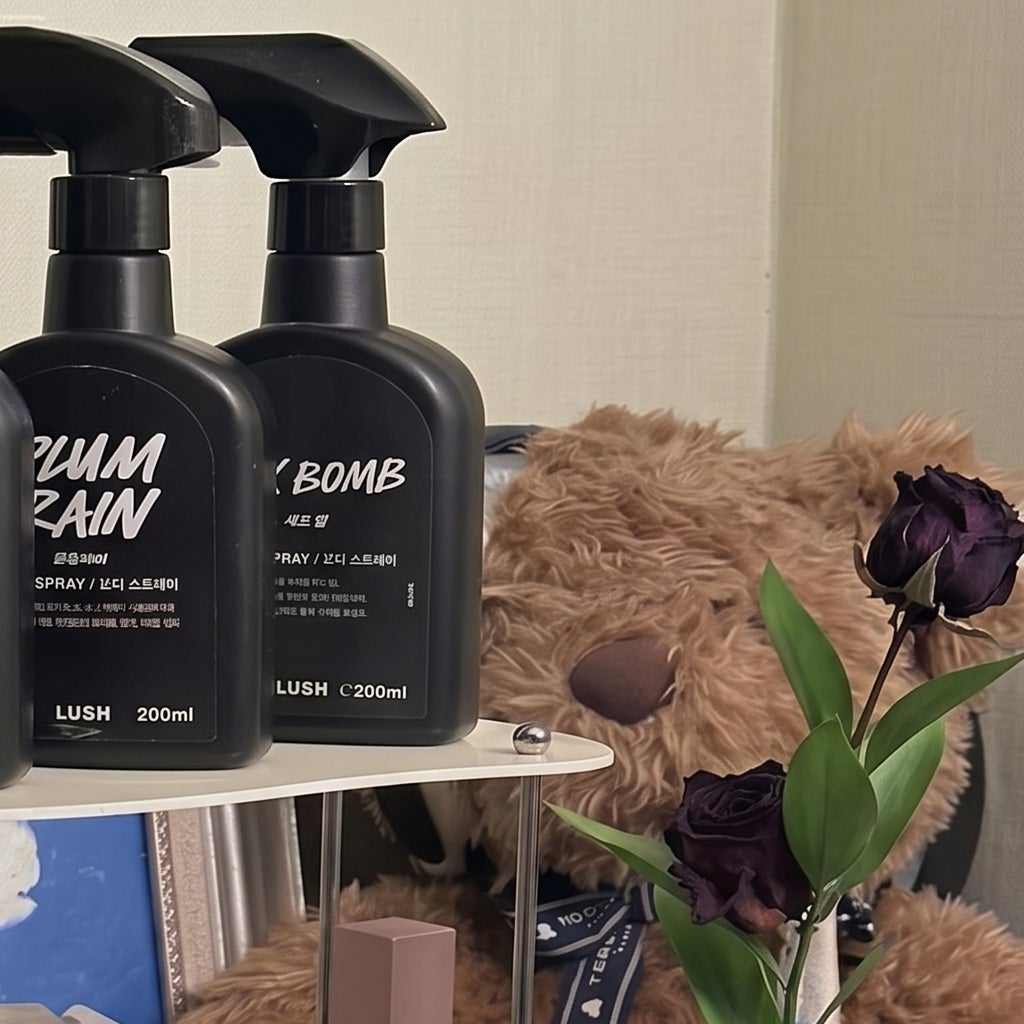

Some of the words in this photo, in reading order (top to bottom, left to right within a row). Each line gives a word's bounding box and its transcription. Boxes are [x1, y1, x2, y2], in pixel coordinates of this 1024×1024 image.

[292, 457, 406, 495] BOMB
[35, 577, 85, 590] SPRAY
[276, 680, 328, 697] LUSH
[56, 705, 111, 721] LUSH
[137, 707, 194, 722] 200ml
